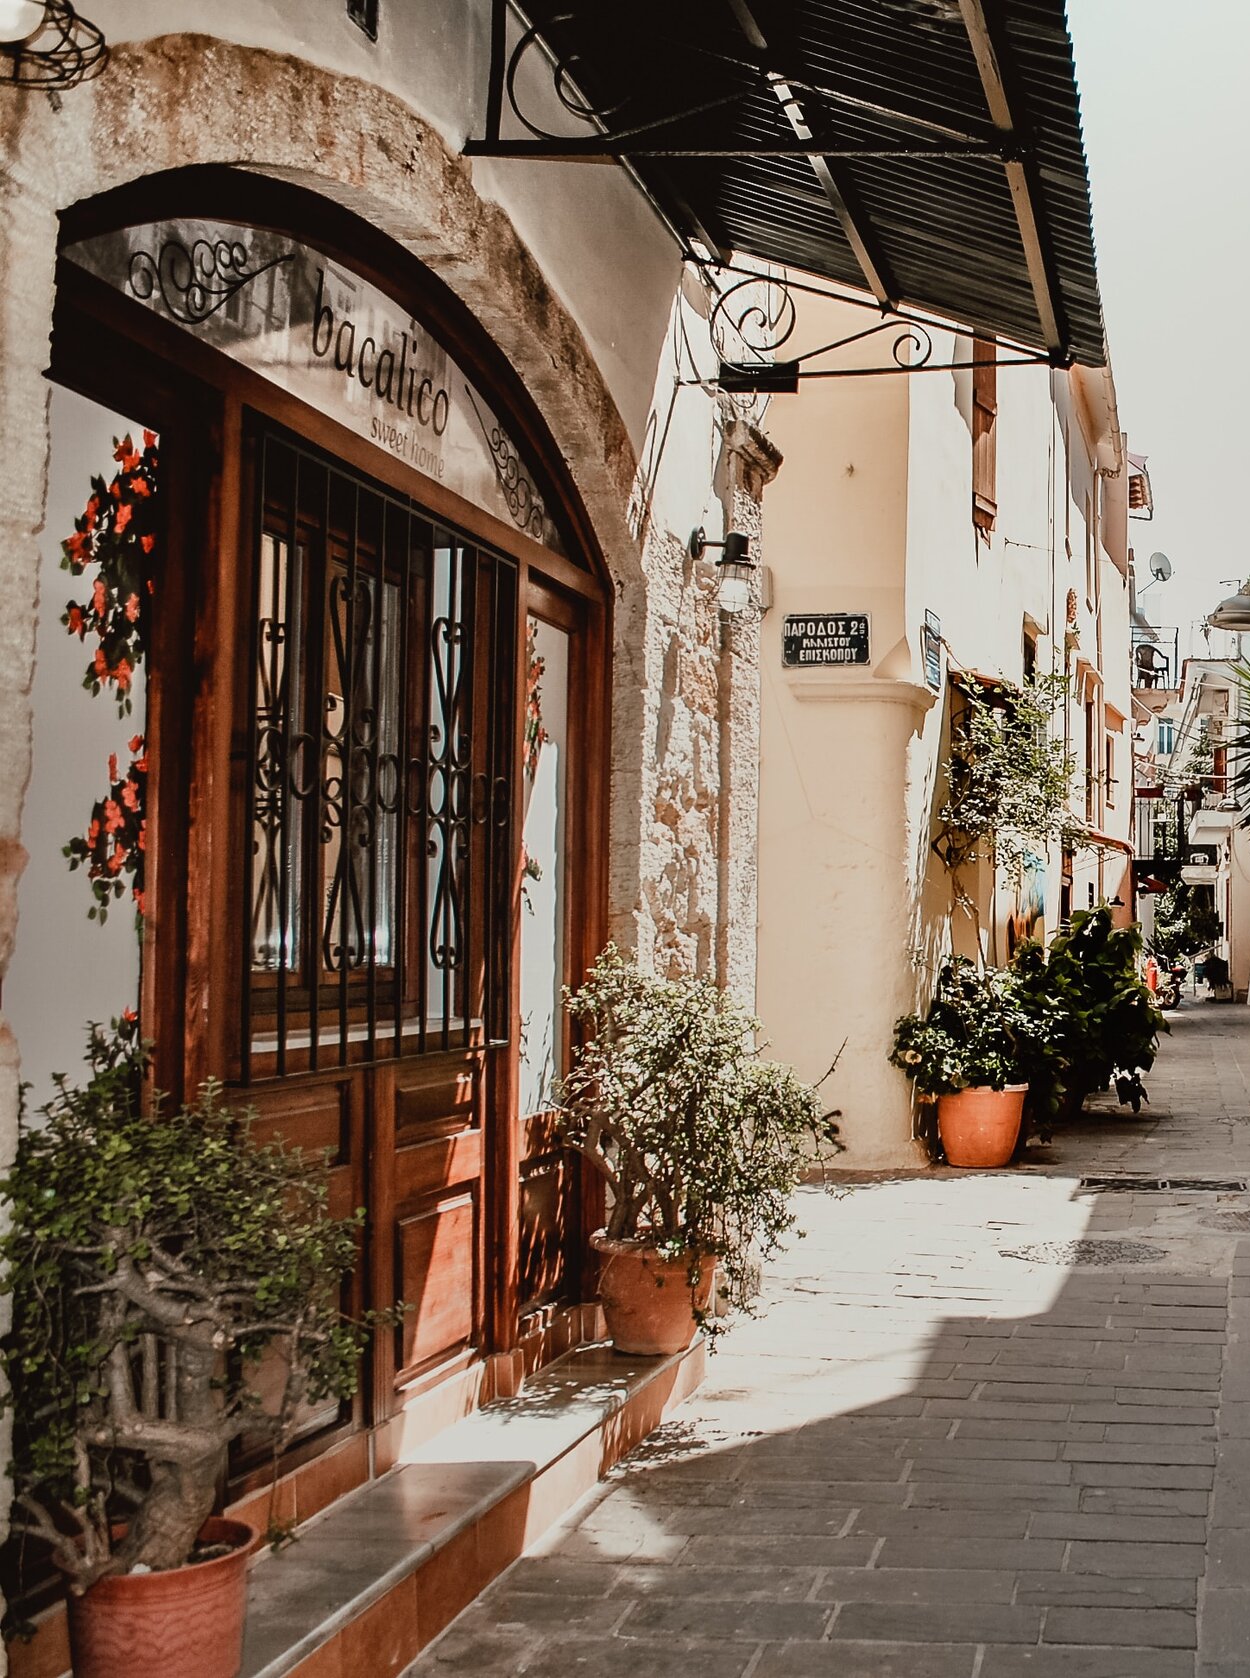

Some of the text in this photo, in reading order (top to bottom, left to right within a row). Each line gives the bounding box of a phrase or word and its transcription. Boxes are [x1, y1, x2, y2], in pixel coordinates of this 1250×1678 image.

[313, 269, 450, 436] bacalico
[371, 417, 445, 478] sweet home
[784, 621, 846, 636] ΠΑΡΟΔΟΣ
[799, 648, 858, 661] ΕΠΙΣΚΟΠΟΥ
